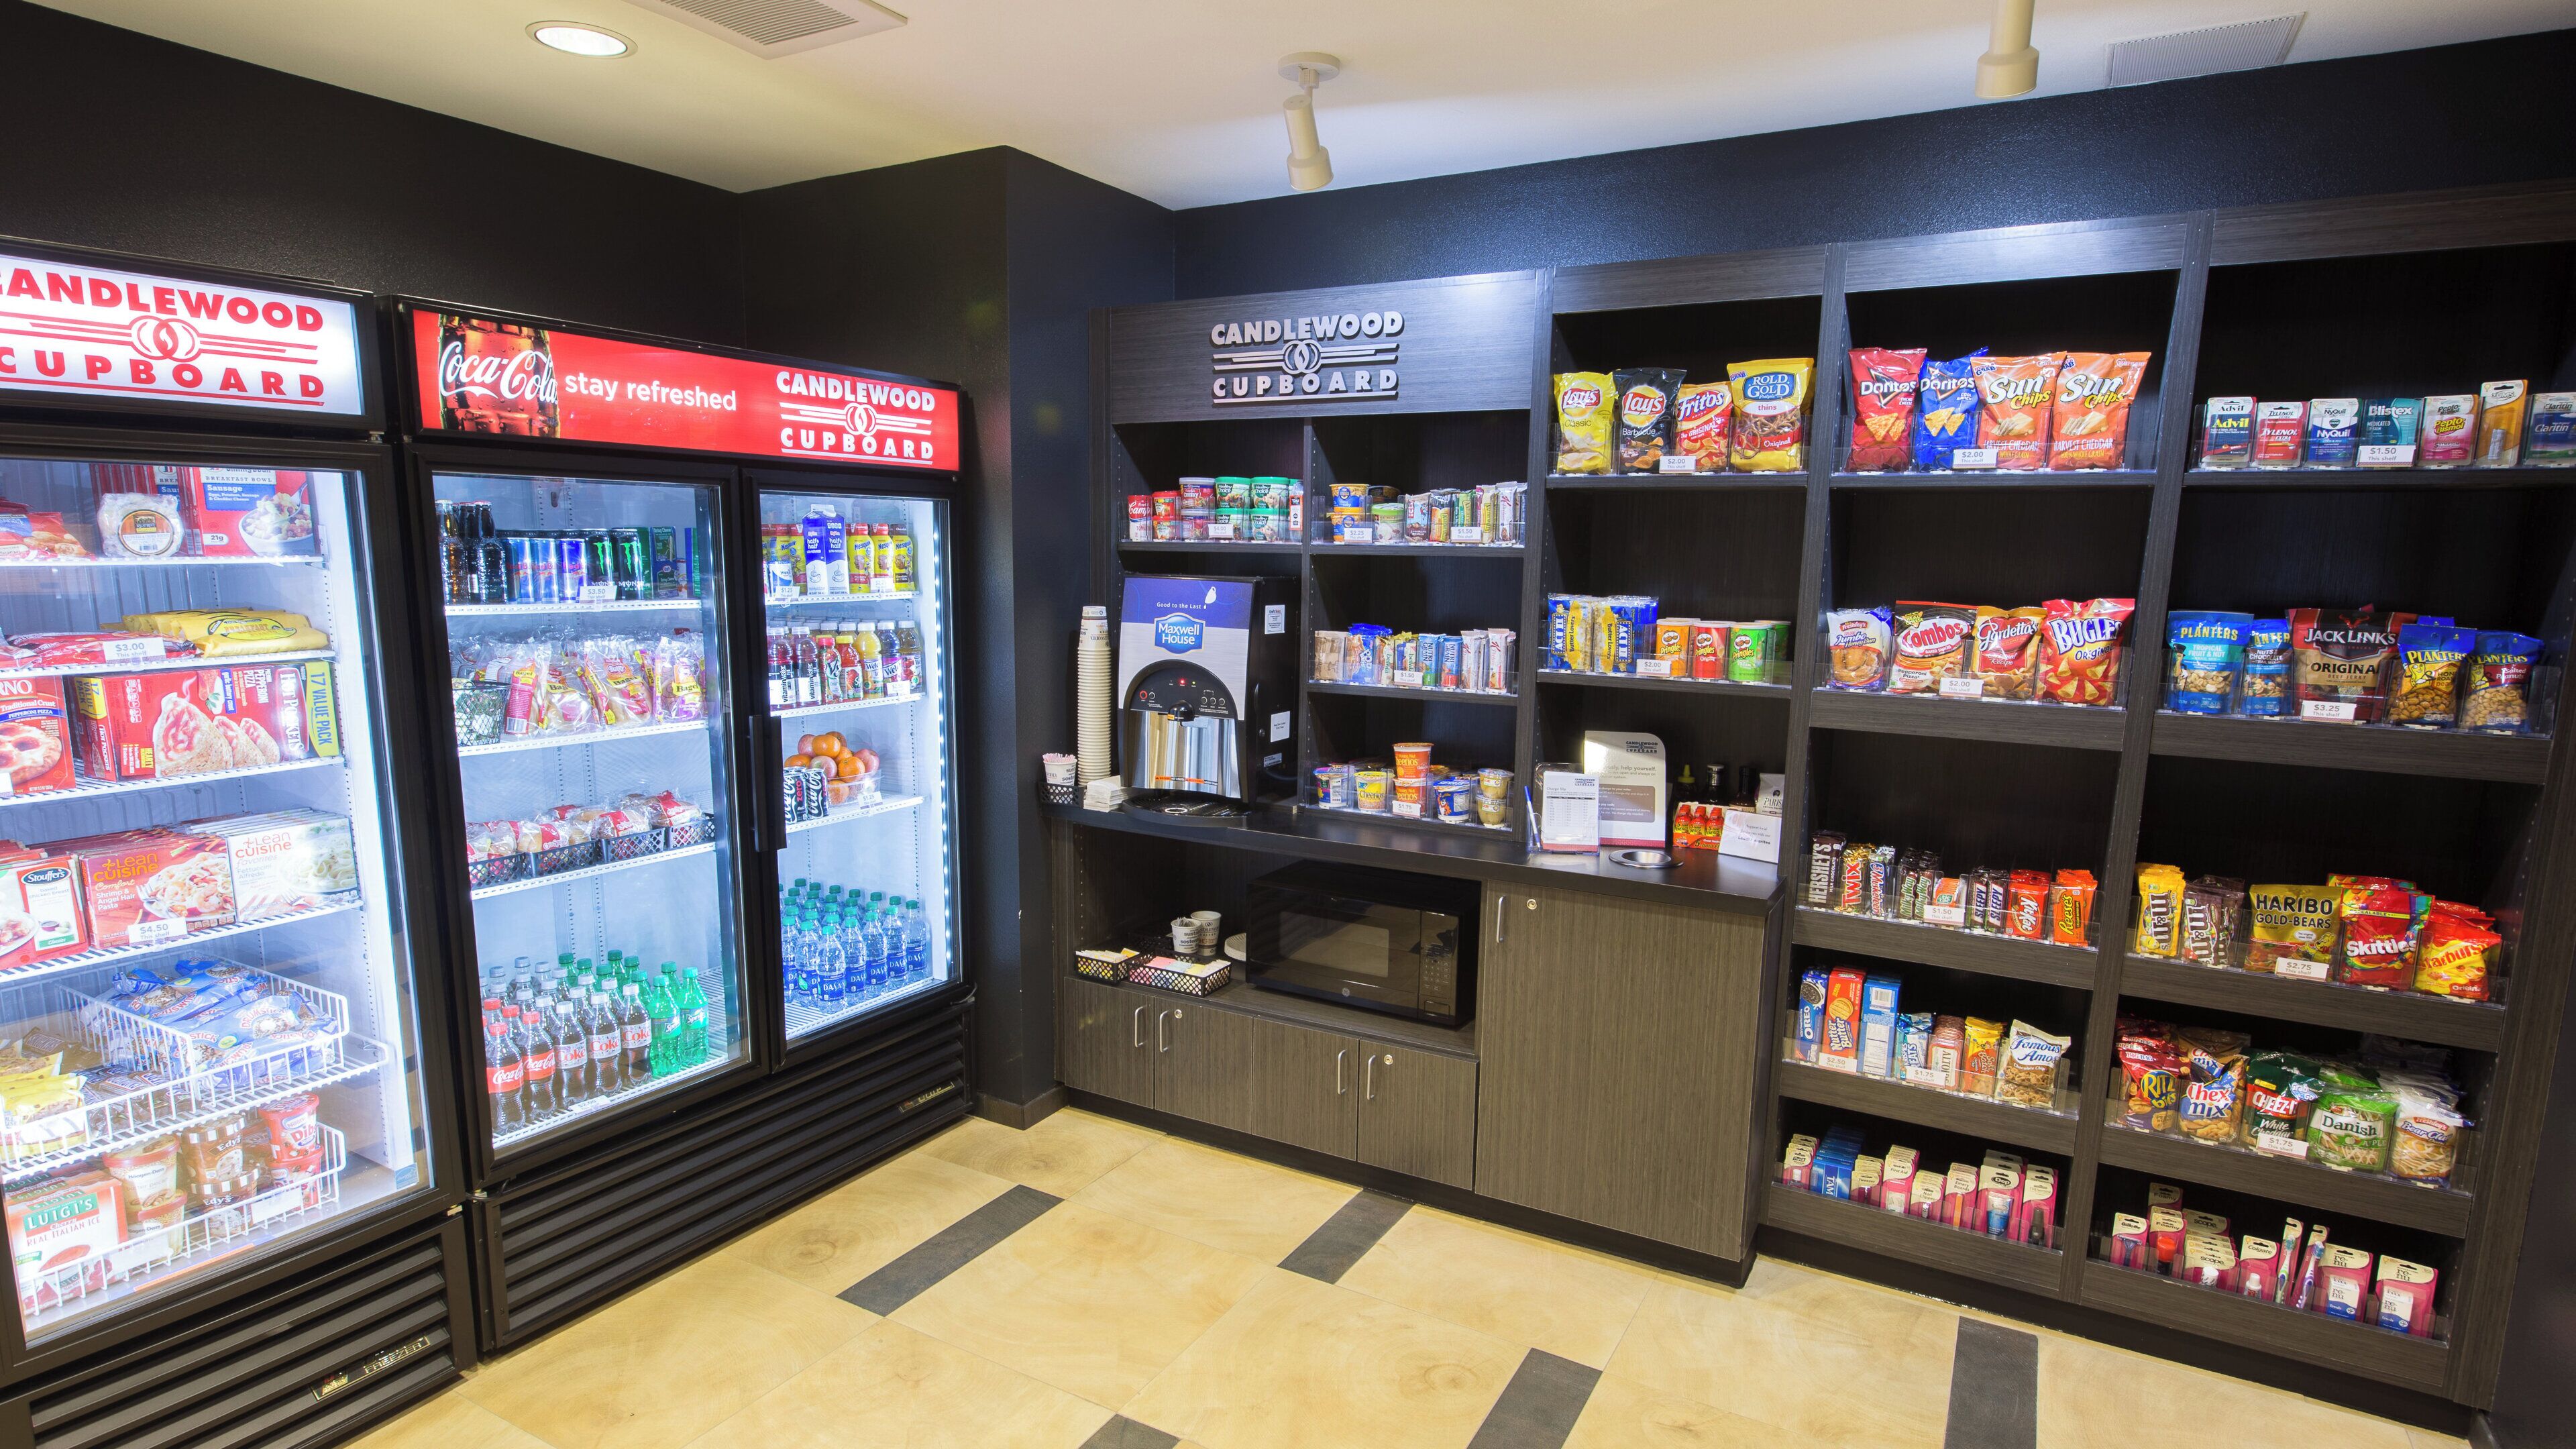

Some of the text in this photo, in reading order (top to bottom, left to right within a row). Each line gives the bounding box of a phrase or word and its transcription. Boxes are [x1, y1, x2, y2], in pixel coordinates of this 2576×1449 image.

[0, 268, 323, 332] ANDLEWOOD
[1211, 311, 1405, 344] CANDLEWOOD
[439, 341, 558, 405] Coca-Cola
[1752, 374, 1789, 386] ROLD
[1213, 370, 1397, 396] CUPBOARD
[1860, 380, 1917, 396] Doritos
[1920, 377, 1974, 392] Doritos
[1986, 374, 2045, 405] Sun
[2059, 374, 2123, 402] Sun
[565, 372, 737, 411] stay refreshed
[776, 371, 936, 413] CANDLEWOOD
[1747, 384, 1790, 398] GOLD
[1624, 393, 1664, 415] Lay's
[2010, 388, 2051, 409] Chips
[2084, 391, 2127, 409] Chips
[1678, 392, 1725, 421] Fritos
[2368, 405, 2413, 418] Blistex
[1565, 419, 1592, 427] Classic
[2212, 418, 2249, 428] Advil
[2436, 423, 2465, 434] Bismol
[2535, 423, 2569, 433] Claritin
[2317, 429, 2351, 438] NyQuil
[781, 427, 934, 459] CUPBOARD
[1764, 437, 1792, 447] Original
[207, 484, 243, 492] Sausage
[1159, 623, 1199, 635] Maxwell
[1978, 621, 2039, 651] Gardetto's
[2181, 627, 2239, 641] PLANTERS
[1162, 634, 1195, 645] House
[1845, 640, 1864, 648] Honey
[2304, 629, 2397, 645] JACK LINK'S
[115, 642, 145, 652] $3.00
[1733, 649, 1754, 658] Pringles
[244, 670, 256, 688] PIZZA
[614, 676, 637, 686] Bagel
[76, 680, 85, 703] PACK
[85, 682, 93, 709] VALUE
[91, 682, 100, 696] 17
[9, 710, 36, 718] PEPPERONI
[311, 672, 333, 746] 17 VALUE PACK
[2314, 704, 2340, 712] $3.25
[1359, 791, 1385, 799] Cheerios
[254, 832, 290, 845] Lean
[117, 853, 158, 867] Lean
[28, 869, 65, 883] Stouffer's
[1809, 843, 1832, 904] HERSHEY'S
[97, 891, 122, 900] Shrimp
[98, 896, 119, 906] Angel
[1975, 887, 1986, 918] SLEEPY
[1990, 887, 2003, 921] SLEEPY
[2255, 894, 2333, 916] HARIBO
[2255, 913, 2331, 929] GOLD-BEARS
[140, 923, 168, 934] $4.50
[2346, 938, 2417, 957] Skittles
[2286, 962, 2312, 970] $2.75
[1804, 1006, 1814, 1040] OREO
[623, 1029, 651, 1042] Coke
[590, 1040, 619, 1052] Coke
[2010, 1036, 2061, 1054] Famous
[556, 1049, 585, 1063] Coke
[2018, 1050, 2057, 1064] Amos
[2144, 1073, 2176, 1098] RITZ
[2187, 1081, 2230, 1103] Chex
[2189, 1102, 2228, 1118] mix
[2261, 1118, 2290, 1130] White
[2322, 1115, 2377, 1136] Danish
[2269, 1139, 2293, 1147] $1.75
[28, 1198, 94, 1229] LUIGI'S
[28, 1216, 101, 1246] REAL ITALIAN ICE
[2121, 1222, 2141, 1230] Gillette
[2248, 1244, 2272, 1254] Colgate
